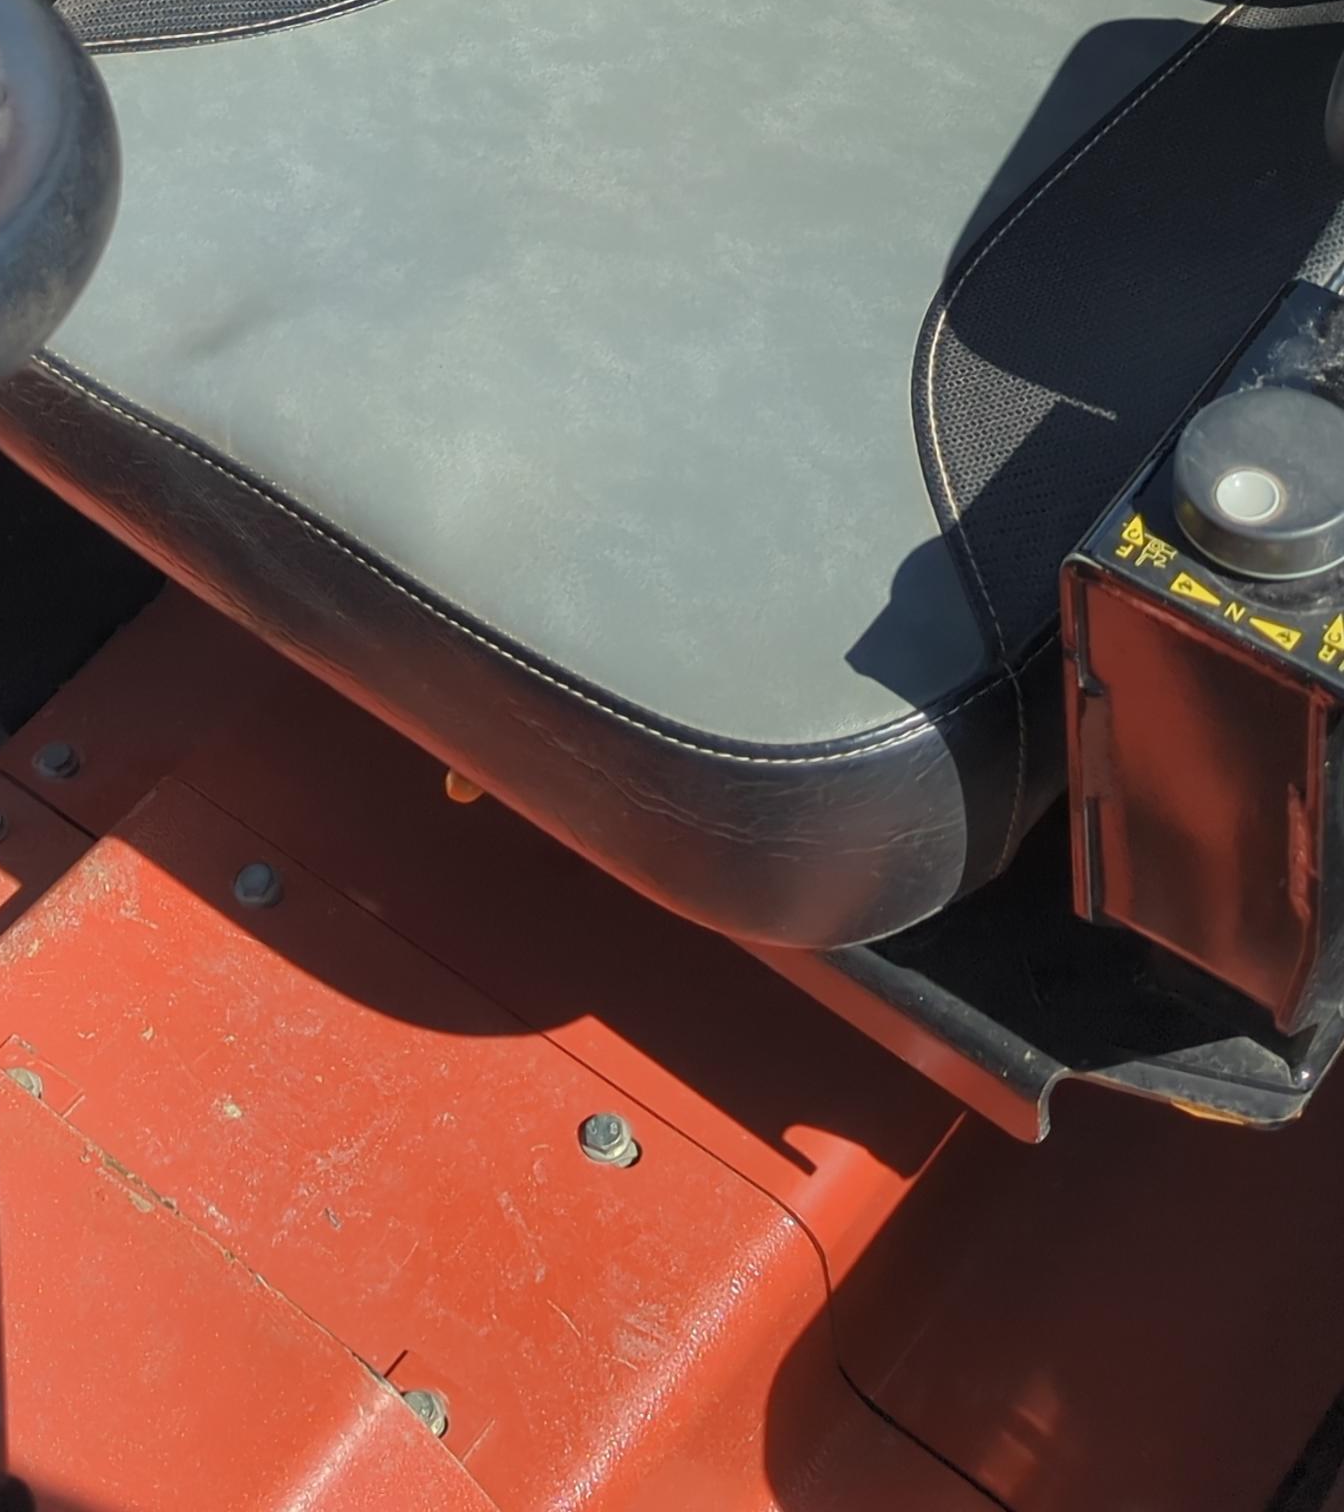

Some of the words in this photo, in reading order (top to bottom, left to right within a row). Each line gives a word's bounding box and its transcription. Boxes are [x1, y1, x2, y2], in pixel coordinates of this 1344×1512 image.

[1115, 544, 1135, 559] F
[1223, 601, 1247, 623] N
[1317, 644, 1337, 664] R
